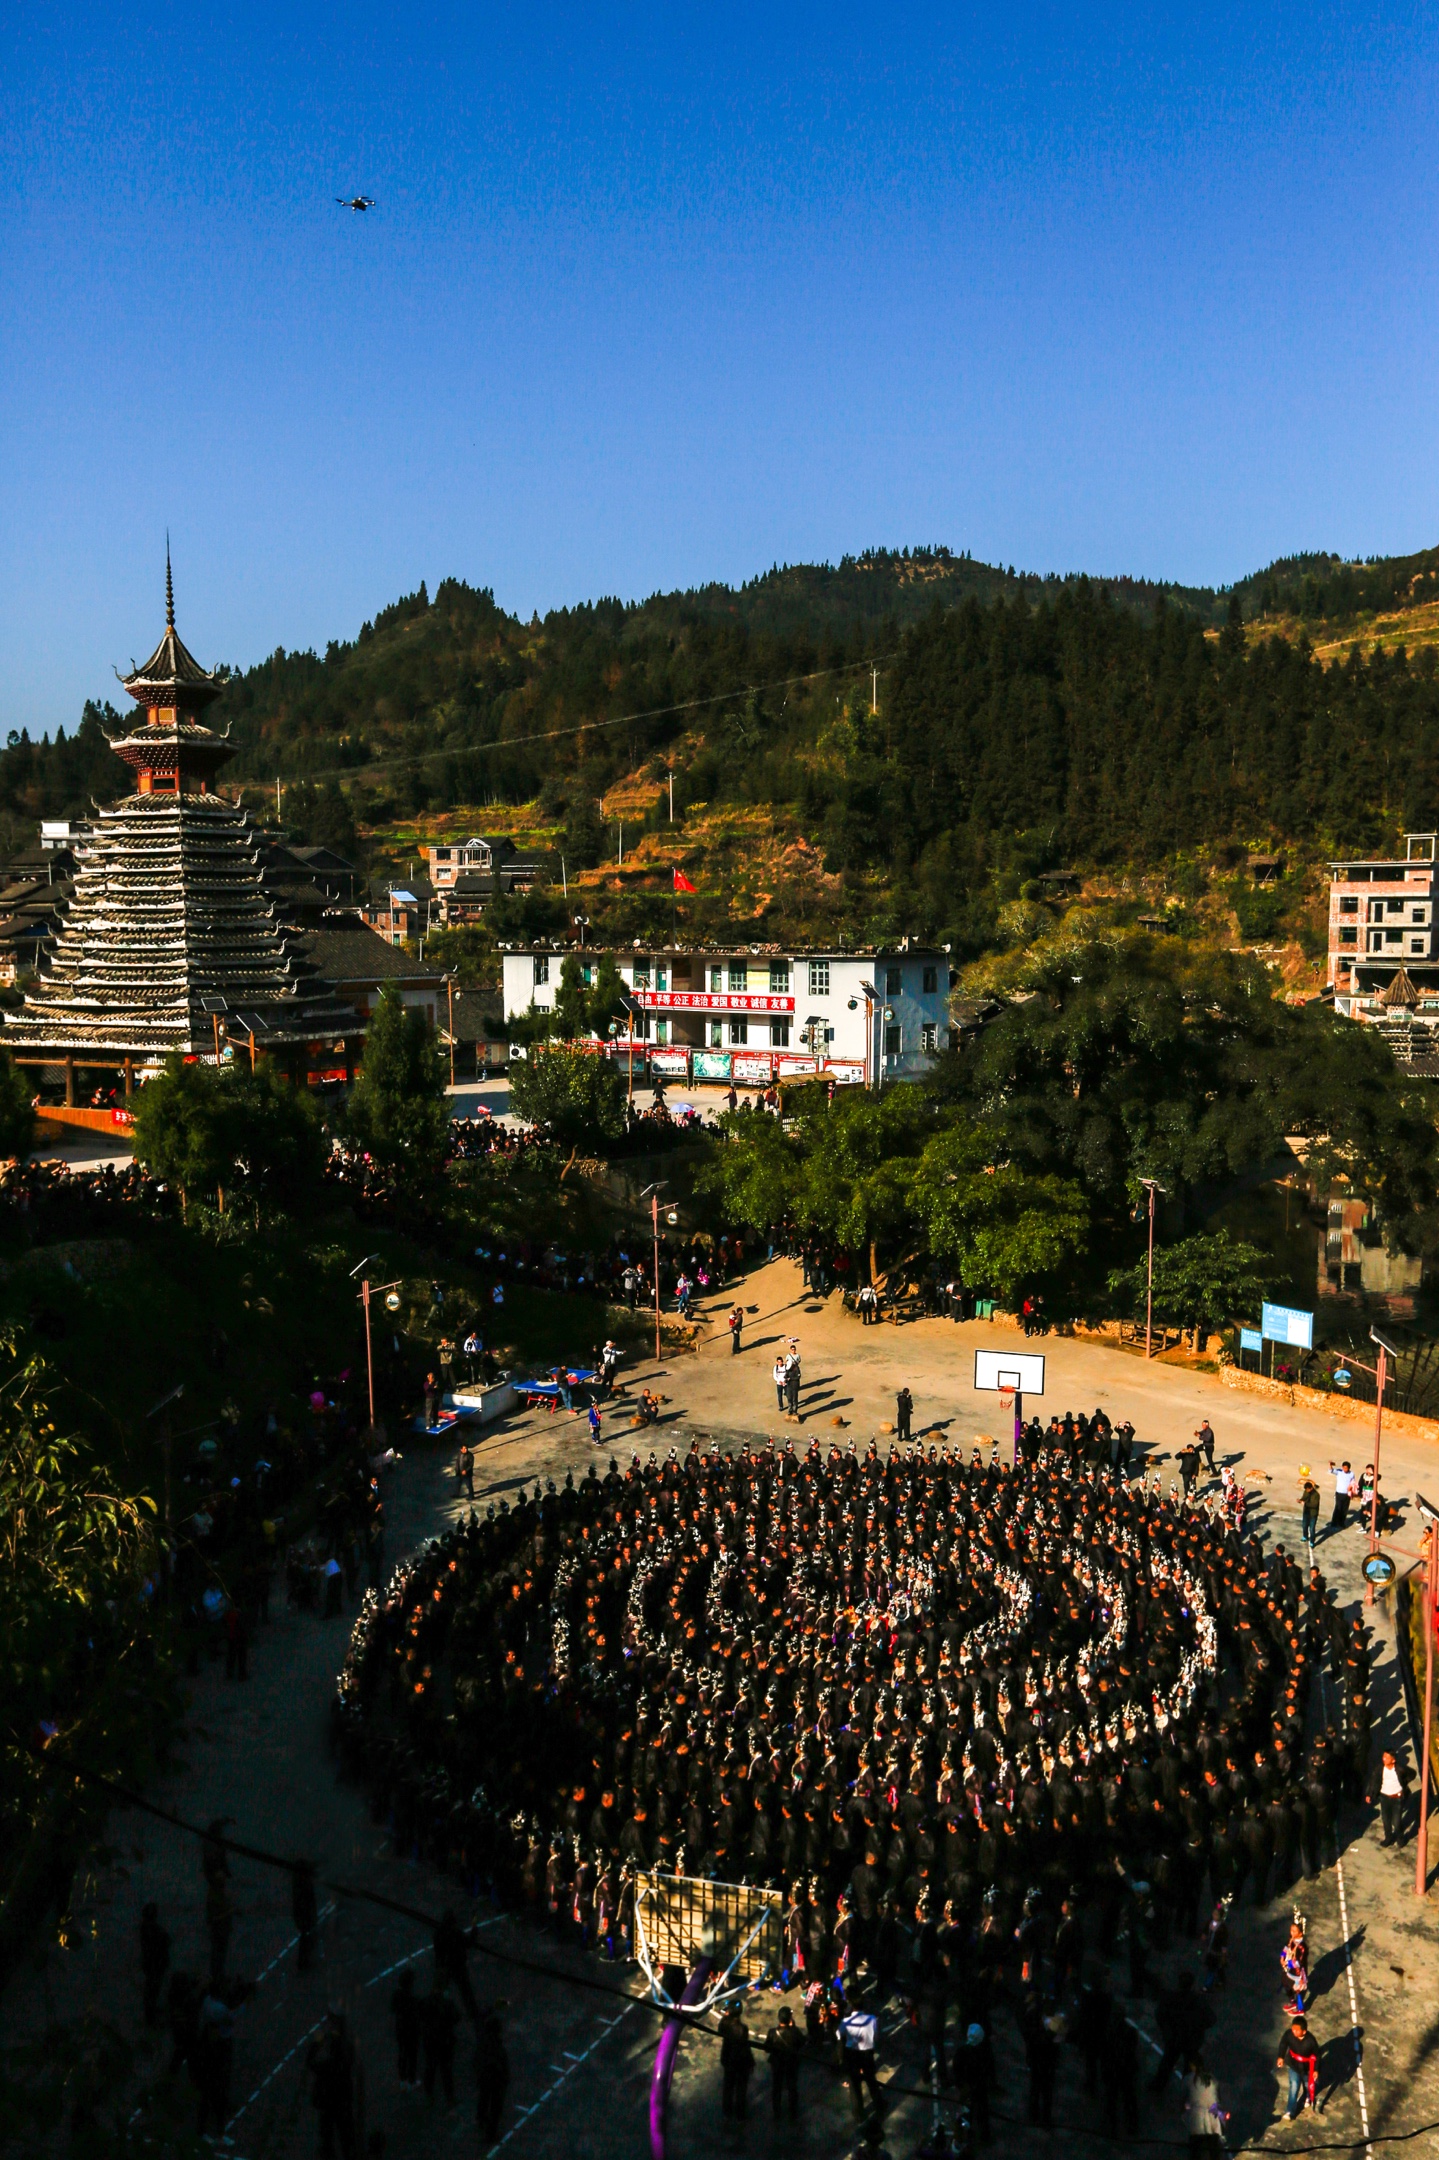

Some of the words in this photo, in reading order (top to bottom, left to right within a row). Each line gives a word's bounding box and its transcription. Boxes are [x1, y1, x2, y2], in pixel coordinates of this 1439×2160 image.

[637, 994, 652, 1004] 自由
[655, 994, 671, 1005] 平等
[673, 995, 689, 1006] 公正
[692, 996, 708, 1007] 法治
[711, 996, 728, 1007] 爱国
[730, 997, 748, 1008] 敬业
[751, 997, 768, 1009] 诚信
[771, 998, 788, 1010] 友善
